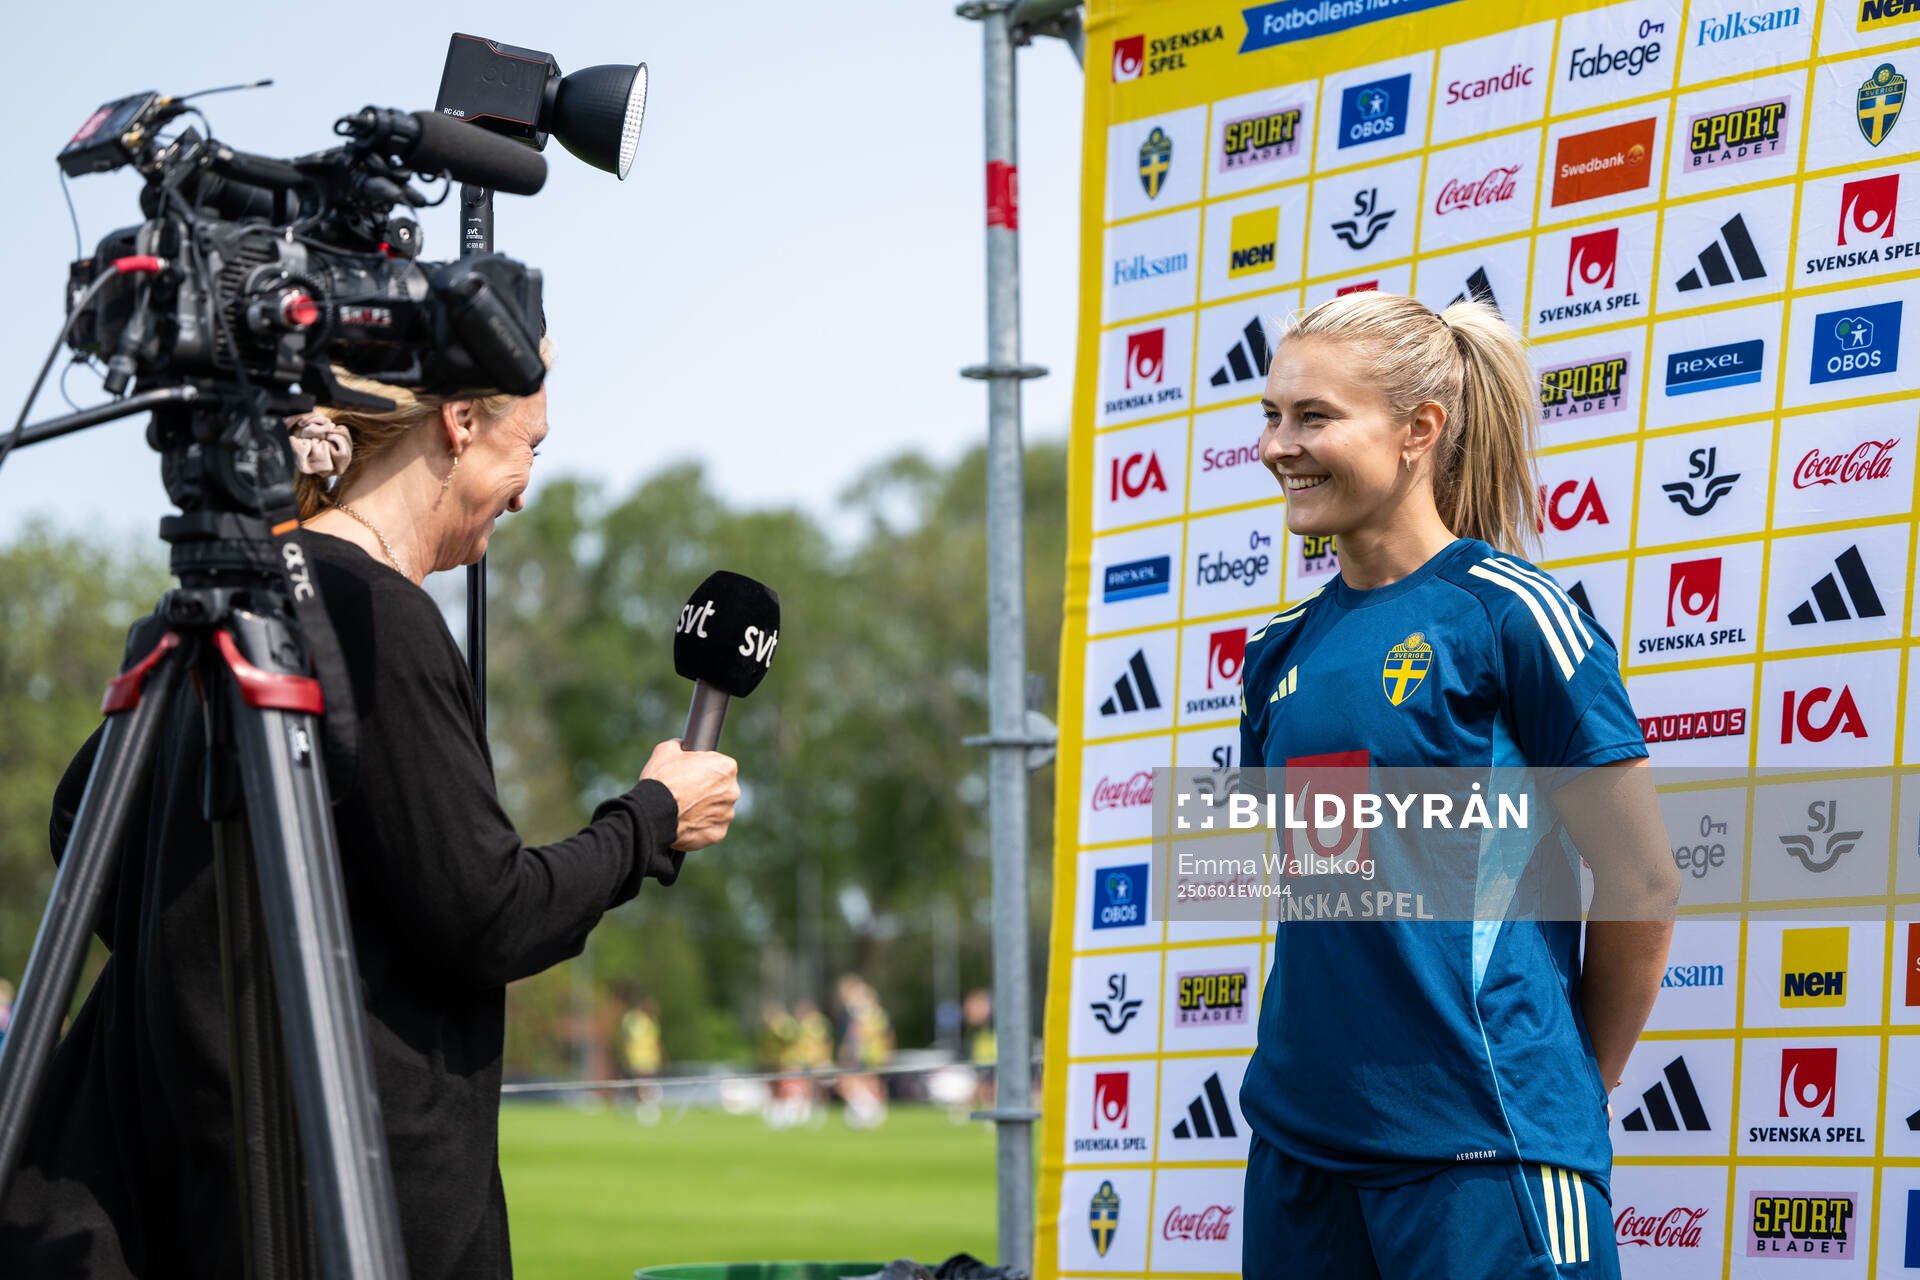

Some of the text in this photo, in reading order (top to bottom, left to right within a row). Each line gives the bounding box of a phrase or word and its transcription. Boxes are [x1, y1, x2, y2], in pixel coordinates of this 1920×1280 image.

[1149, 25, 1225, 57] SVENSKA
[1696, 6, 1801, 47] Folksam
[1149, 53, 1188, 76] SPEL
[1568, 41, 1662, 83] Fabege
[1446, 63, 1535, 106] Scandic
[1224, 109, 1300, 157] SPORT
[1349, 115, 1396, 141] OBOS
[1690, 102, 1787, 153] SPORT
[1225, 144, 1298, 169] BLADET
[1560, 152, 1626, 180] Swedbank
[1692, 138, 1779, 168] BLADET
[1354, 187, 1378, 217] SJ
[1435, 162, 1525, 216] Coca-Cola
[1112, 251, 1189, 287] Folksam
[1805, 248, 1881, 275] SVENSKA
[1538, 292, 1641, 325] SVENSKA SPEL
[1826, 348, 1883, 375] OBOS
[1541, 358, 1628, 408] SPORT
[1104, 386, 1184, 416] SVENSKA SPEL
[1202, 436, 1260, 473] Scand
[1689, 446, 1718, 481] SJ
[1792, 437, 1901, 490] Coca-Cola
[1110, 450, 1168, 503] ICA
[1196, 550, 1270, 588] Fabege
[676, 600, 716, 639] svt
[738, 625, 778, 669] svt
[1394, 651, 1426, 660] SVERIGE
[1638, 628, 1747, 655] SVENSKA SPEL
[1185, 694, 1237, 715] SVENSKA
[1780, 684, 1869, 745] ICA
[1640, 710, 1744, 741] AUHAUS
[1211, 745, 1233, 774] SJ
[1807, 799, 1837, 834] SJ
[1102, 904, 1138, 923] OBOS
[1360, 890, 1434, 920] SPEL
[1108, 973, 1126, 1001] SJ
[1179, 972, 1248, 1010] SPORT
[1181, 1008, 1244, 1024] BLADET
[1073, 1136, 1147, 1153] SVENSKA SPEL
[1749, 1127, 1865, 1143] SVENSKA SPEL
[1456, 1149, 1497, 1161] AEROREADY
[1163, 1204, 1236, 1242] Coca-Cola
[1614, 1206, 1709, 1248] Coca-Cola
[1753, 1196, 1854, 1240] SPORT
[1756, 1239, 1848, 1255] BLADET
